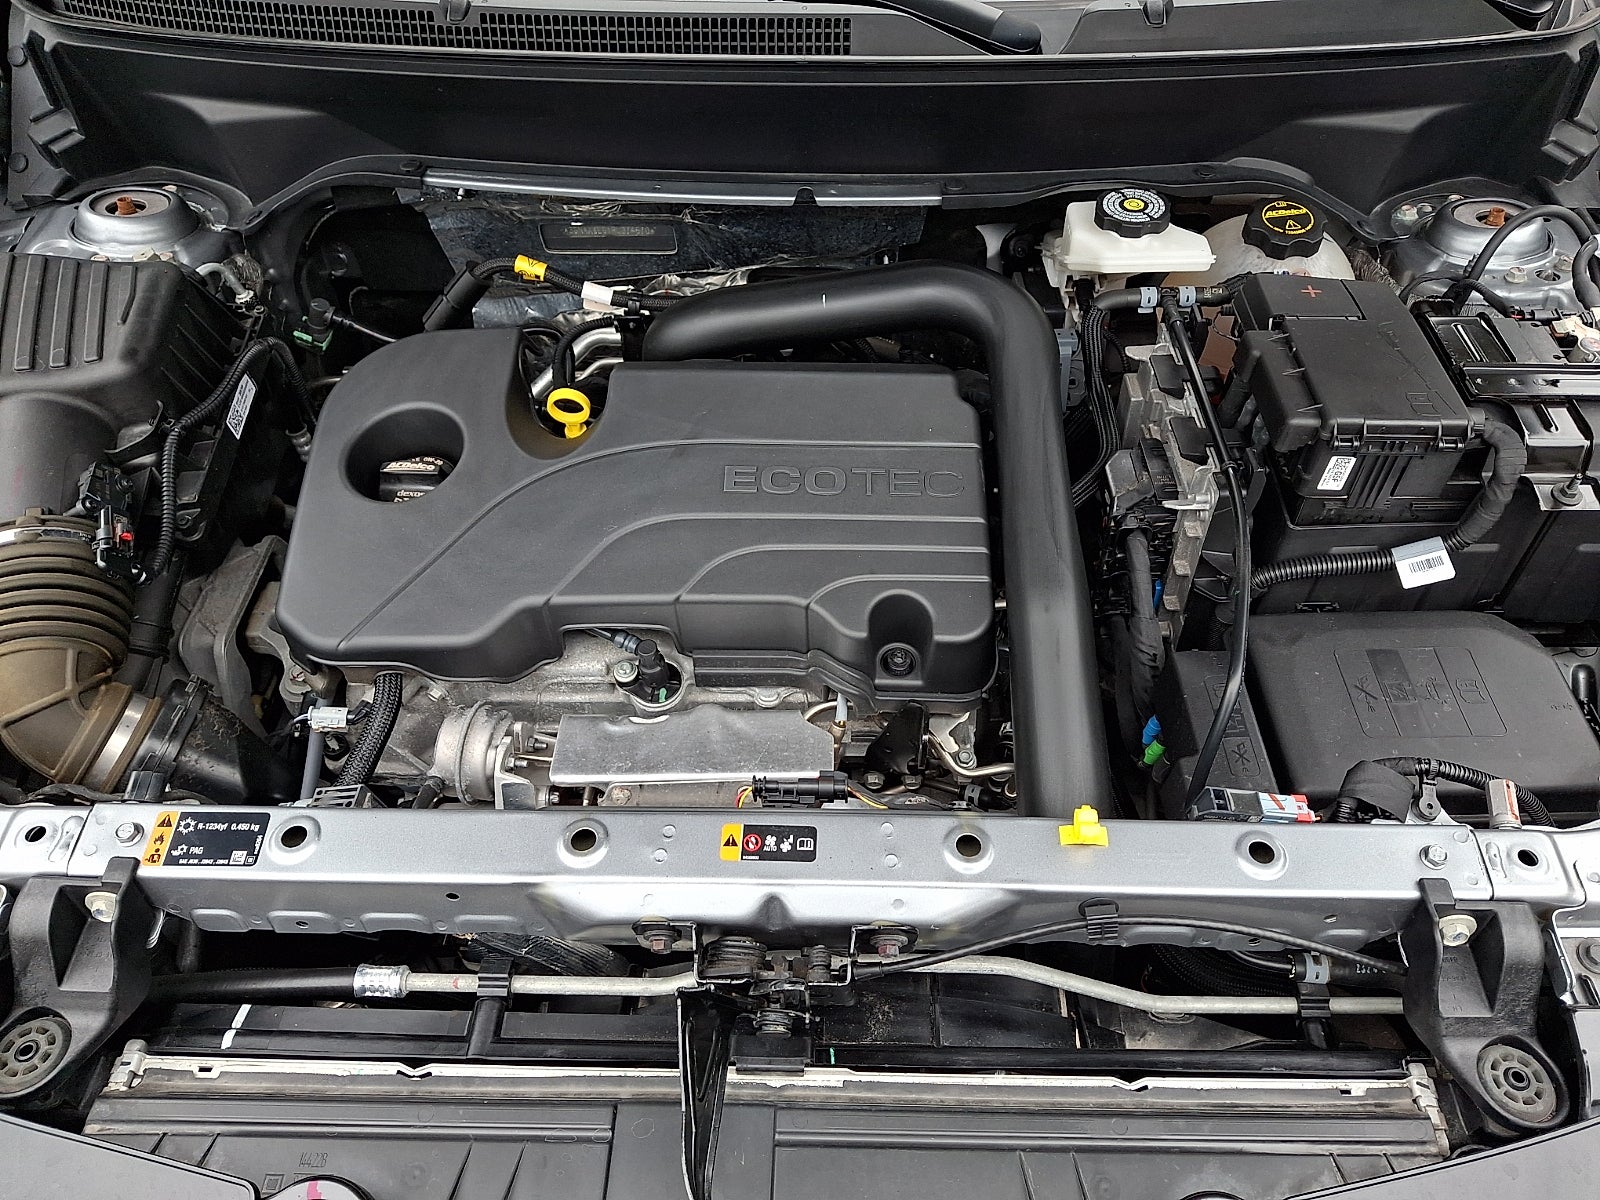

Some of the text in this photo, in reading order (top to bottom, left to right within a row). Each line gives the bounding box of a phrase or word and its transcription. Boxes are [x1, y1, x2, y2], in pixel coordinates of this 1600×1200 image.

[386, 461, 436, 471] ACDelco
[723, 465, 965, 498] ECOTEC
[197, 822, 260, 832] R-1234yf 0.450 kg
[188, 846, 204, 855] PAG
